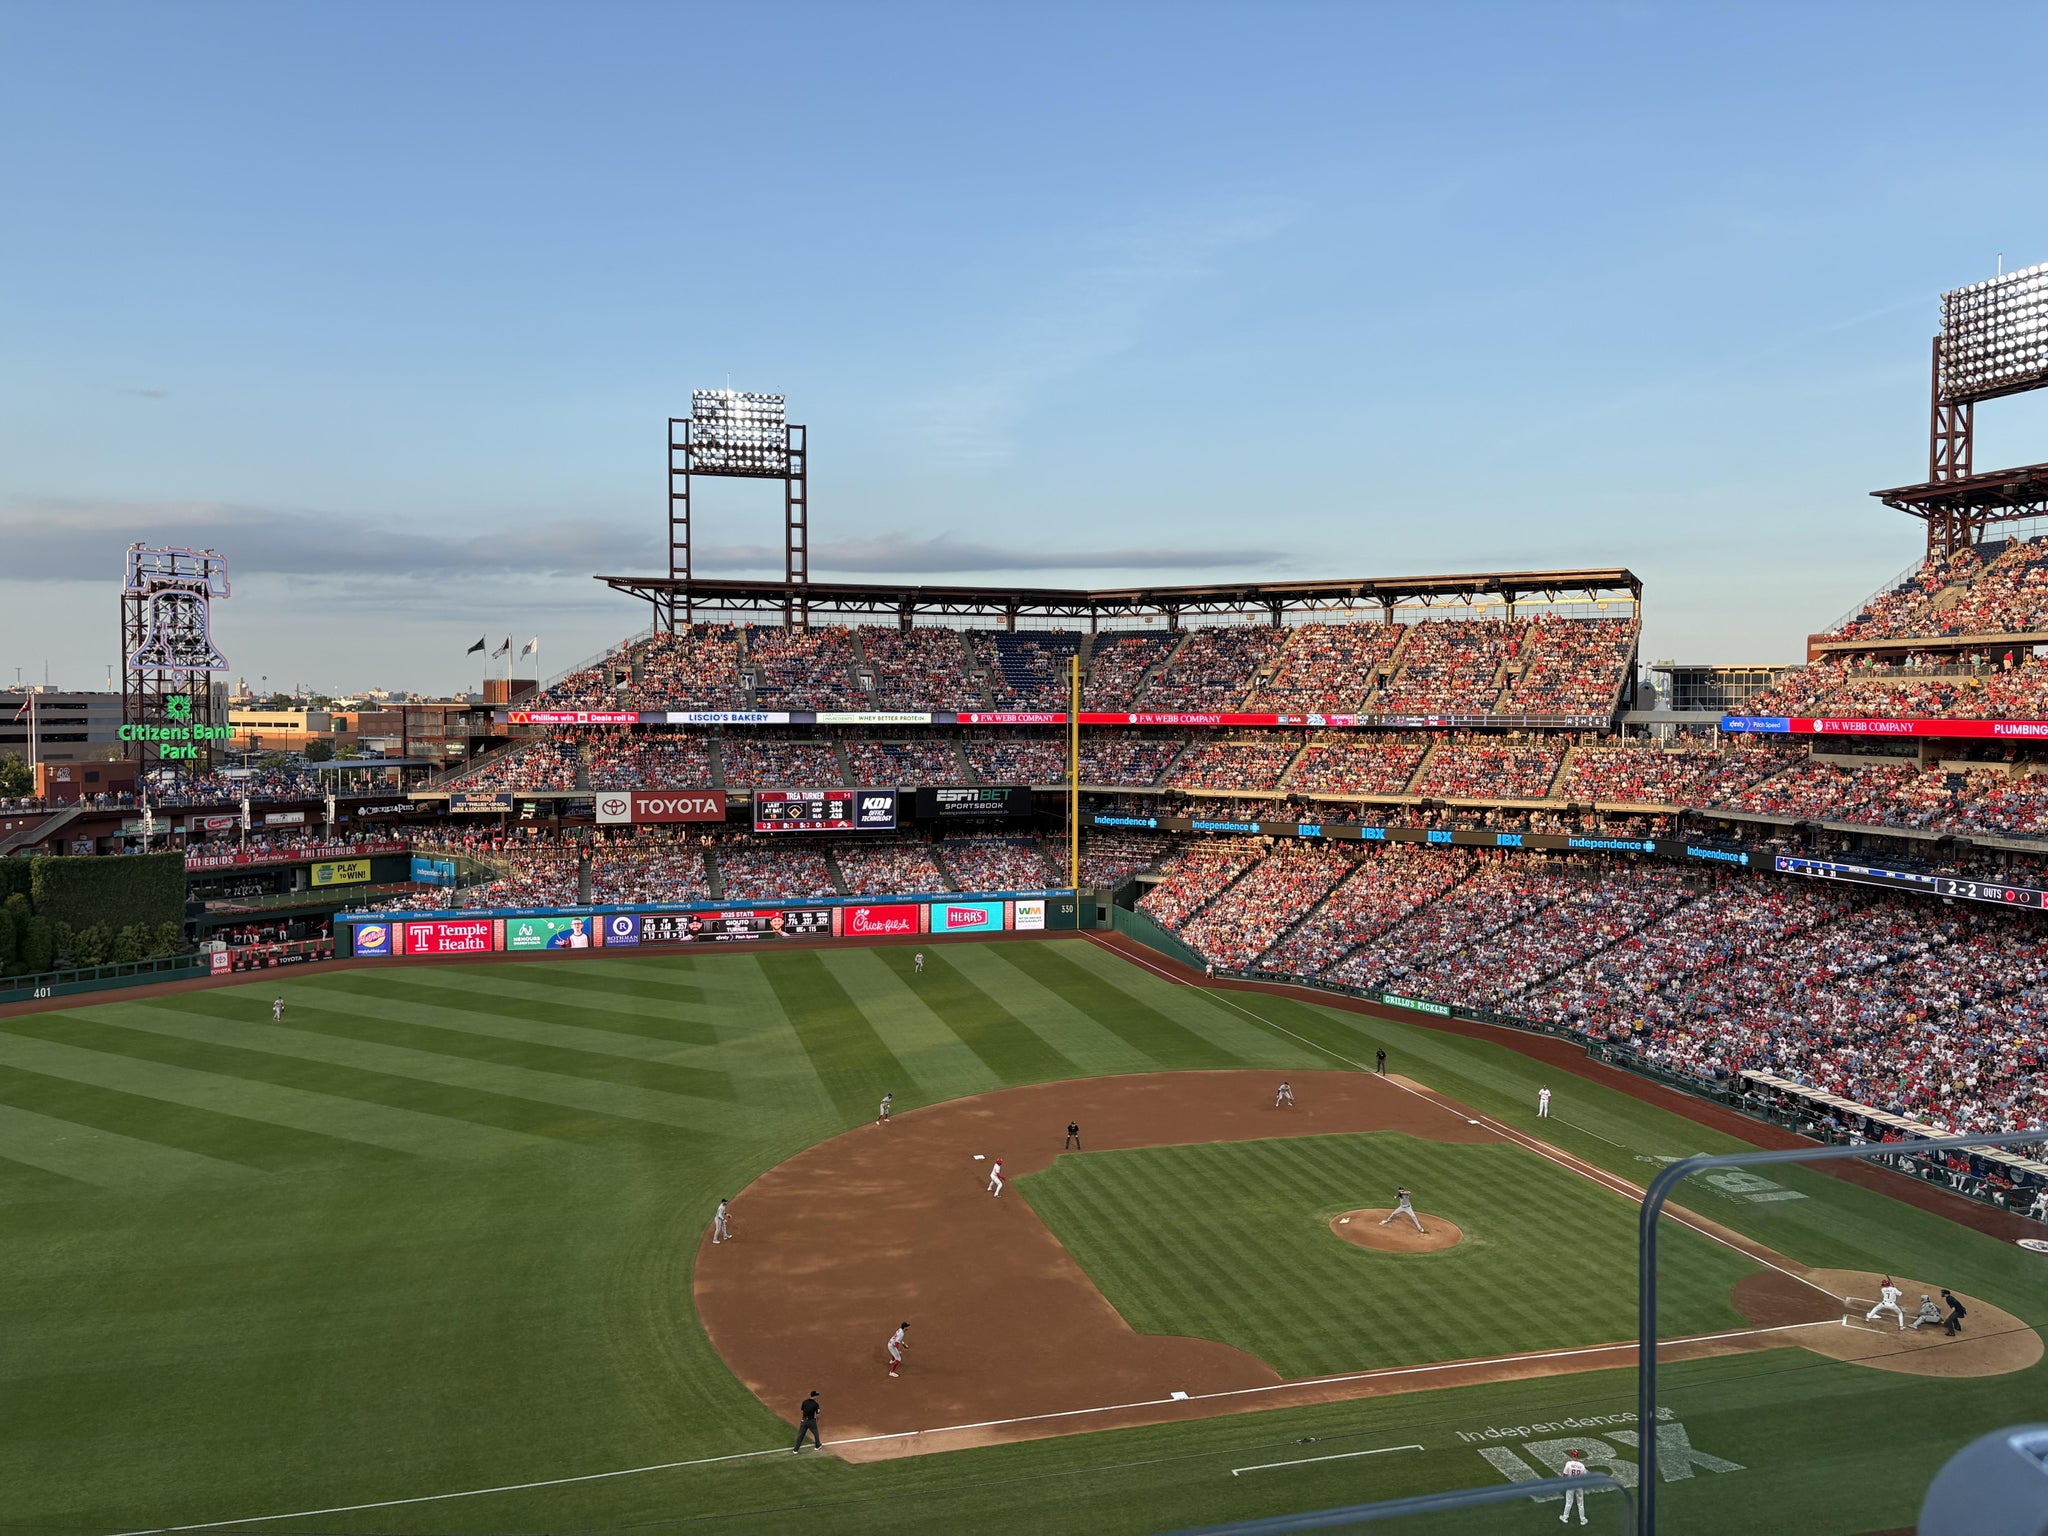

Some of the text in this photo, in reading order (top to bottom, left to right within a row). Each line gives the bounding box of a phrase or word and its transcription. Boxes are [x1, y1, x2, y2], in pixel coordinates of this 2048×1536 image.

[995, 714, 1017, 722] WEBB
[1018, 714, 1054, 722] COMPANY
[1729, 720, 1744, 728] xfinity
[1825, 722, 1914, 732] F.W. WEBB COMPANY
[1994, 724, 2048, 735] PLUMBING
[119, 722, 236, 740] Citizens Bank
[160, 742, 198, 759] Park
[786, 792, 824, 800] TREA TURNER
[936, 788, 1012, 802] ESPN BET
[636, 798, 718, 814] TOYOTA
[945, 802, 1004, 810] SPORTSBOOK
[1094, 816, 1147, 827] Independence
[1192, 820, 1249, 831] Independence
[1298, 825, 1321, 836] IBX
[1361, 828, 1385, 840] IBX
[1428, 831, 1452, 842] IBX
[1497, 834, 1522, 846] IBX
[1568, 838, 1641, 850] Independence
[1687, 846, 1738, 862] Independence
[338, 864, 357, 872] PLAY
[347, 870, 366, 880] WIN!
[1948, 882, 1956, 894] 2
[1968, 884, 1976, 897] 2
[1984, 889, 2002, 900] OUTS
[1060, 904, 1074, 913] 330
[853, 909, 910, 932] Chick-fil-A
[950, 911, 982, 922] HERR'S
[438, 924, 488, 937] Temple
[619, 922, 626, 930] R
[438, 938, 485, 950] Health
[280, 955, 302, 964] TOYOTA
[33, 986, 52, 998] 401
[1386, 996, 1448, 1014] GRILLO'S PICKLES
[1456, 1412, 1638, 1442] Independence
